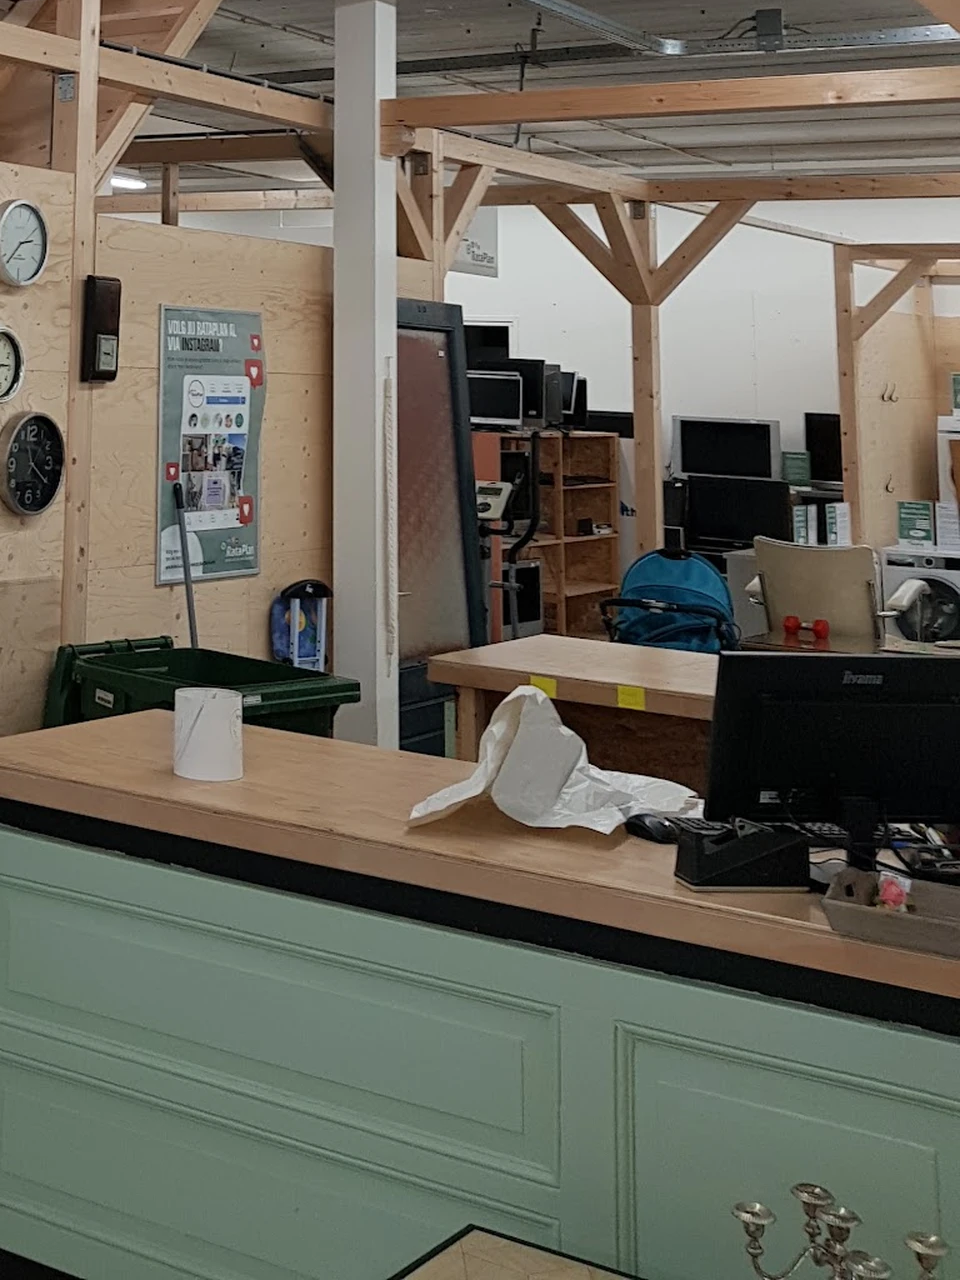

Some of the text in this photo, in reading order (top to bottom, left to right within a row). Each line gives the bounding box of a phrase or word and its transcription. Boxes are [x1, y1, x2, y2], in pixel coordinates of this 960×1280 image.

[167, 320, 186, 335] VOLG
[196, 321, 228, 337] RATAPLAN
[167, 336, 180, 351] VIA
[26, 425, 38, 442] 12
[8, 457, 16, 473] 9
[44, 456, 53, 470] 3
[24, 489, 33, 504] 6
